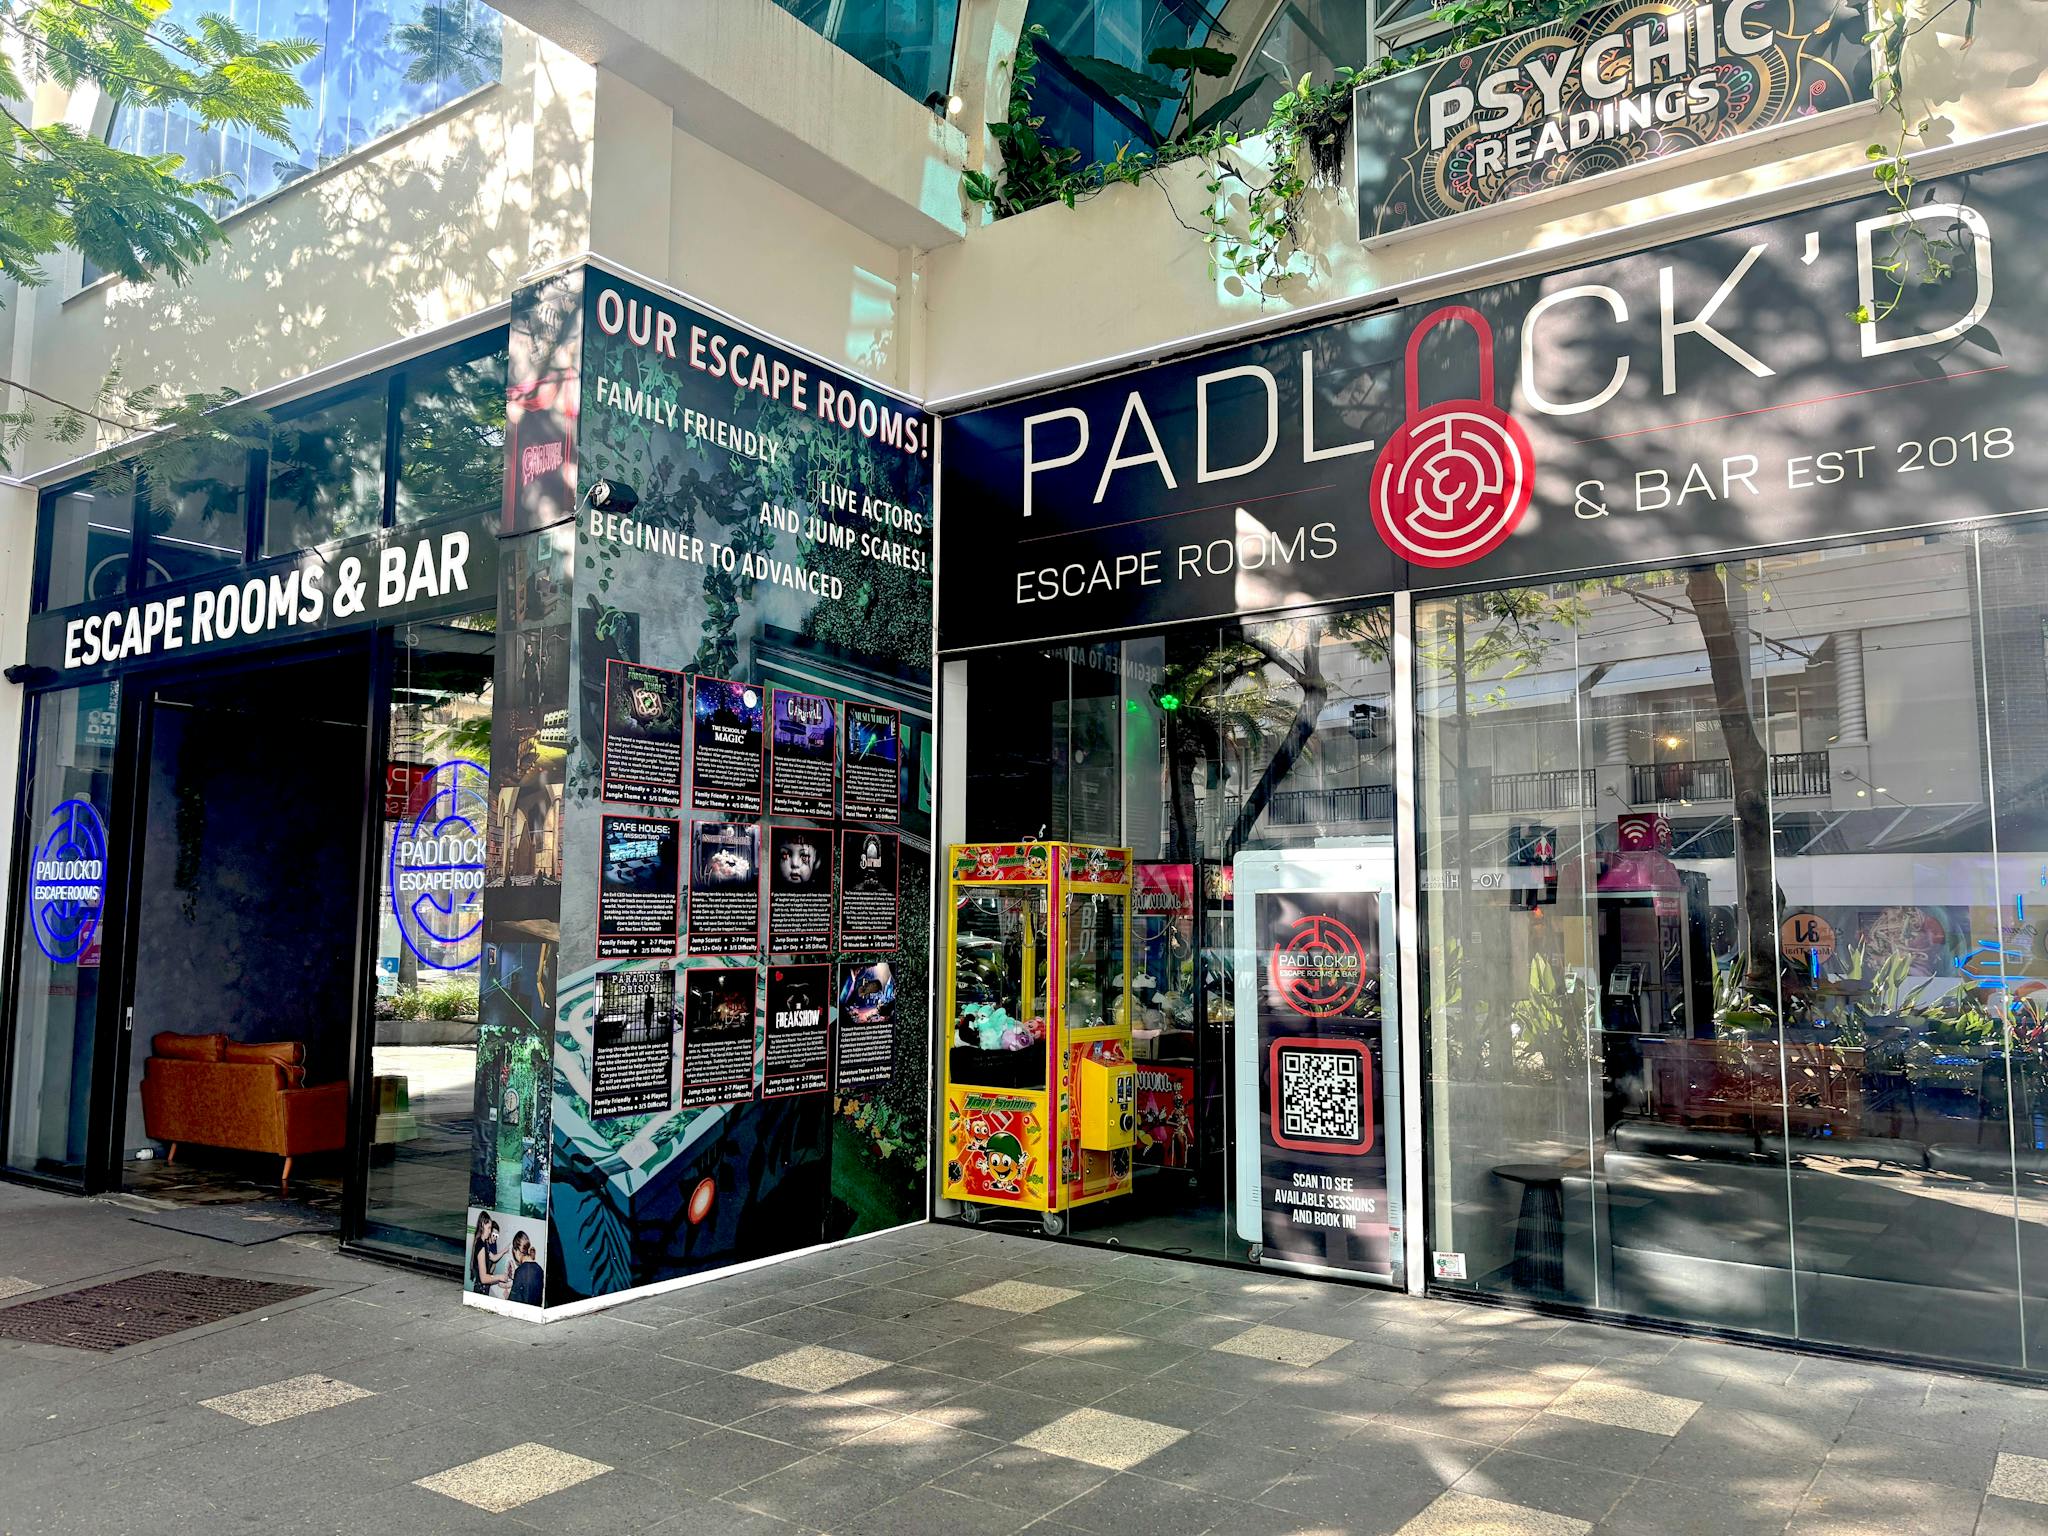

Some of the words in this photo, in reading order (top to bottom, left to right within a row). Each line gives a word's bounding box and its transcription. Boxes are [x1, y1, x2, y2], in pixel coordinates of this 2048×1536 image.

[1429, 0, 1773, 150] PSYCHIC
[1475, 71, 1721, 178] READINGS
[597, 289, 677, 359] OUR
[689, 324, 808, 412] ESCAPE
[817, 380, 928, 458] ROOMS!
[597, 376, 678, 428] FAMILY
[684, 409, 779, 464] FRIENDLY
[820, 481, 857, 514] LIVE
[862, 495, 923, 534] ACTORS
[1016, 554, 1162, 604] ESCAPE
[1177, 522, 1338, 580] ROOMS
[1574, 479, 1609, 520] &
[1634, 452, 1761, 513] BAR
[1787, 445, 1876, 490] EST
[1897, 426, 2016, 474] 2018
[759, 502, 800, 534] AND
[805, 515, 856, 551] JUMP
[860, 534, 926, 573] SCARES!
[590, 510, 704, 564] BEGINNER
[710, 543, 735, 571] TO
[741, 553, 843, 600] ADVANCED
[64, 596, 185, 669] ESCAPE
[191, 563, 325, 645] ROOMS
[333, 556, 365, 618] &
[378, 531, 470, 607] BAR
[788, 700, 822, 721] CARNIVAL
[714, 732, 744, 744] MAGIC
[607, 783, 624, 791] Family
[625, 784, 645, 792] Friendly
[658, 796, 679, 804] Difficulty
[612, 822, 636, 832] SAFE
[638, 824, 670, 834] HOUSE:
[36, 859, 102, 880] PADLOCK'D
[400, 872, 451, 891] ESCAPE
[1280, 954, 1358, 968] PADLOCK'D
[612, 974, 661, 984] PARADISE
[620, 984, 656, 994] PRISON
[776, 1009, 820, 1028] FREAKSHOW
[612, 1096, 631, 1104] Friendly
[647, 1101, 668, 1109] Difficulty
[1293, 1173, 1318, 1189] SCAN
[1320, 1176, 1332, 1190] TO
[1334, 1177, 1354, 1192] SEE
[1275, 1189, 1325, 1208] AVAILABLE
[1326, 1194, 1375, 1212] SESSIONS
[1292, 1209, 1312, 1224] AND
[1314, 1211, 1340, 1228] BOOK
[1342, 1214, 1356, 1230] IN!
